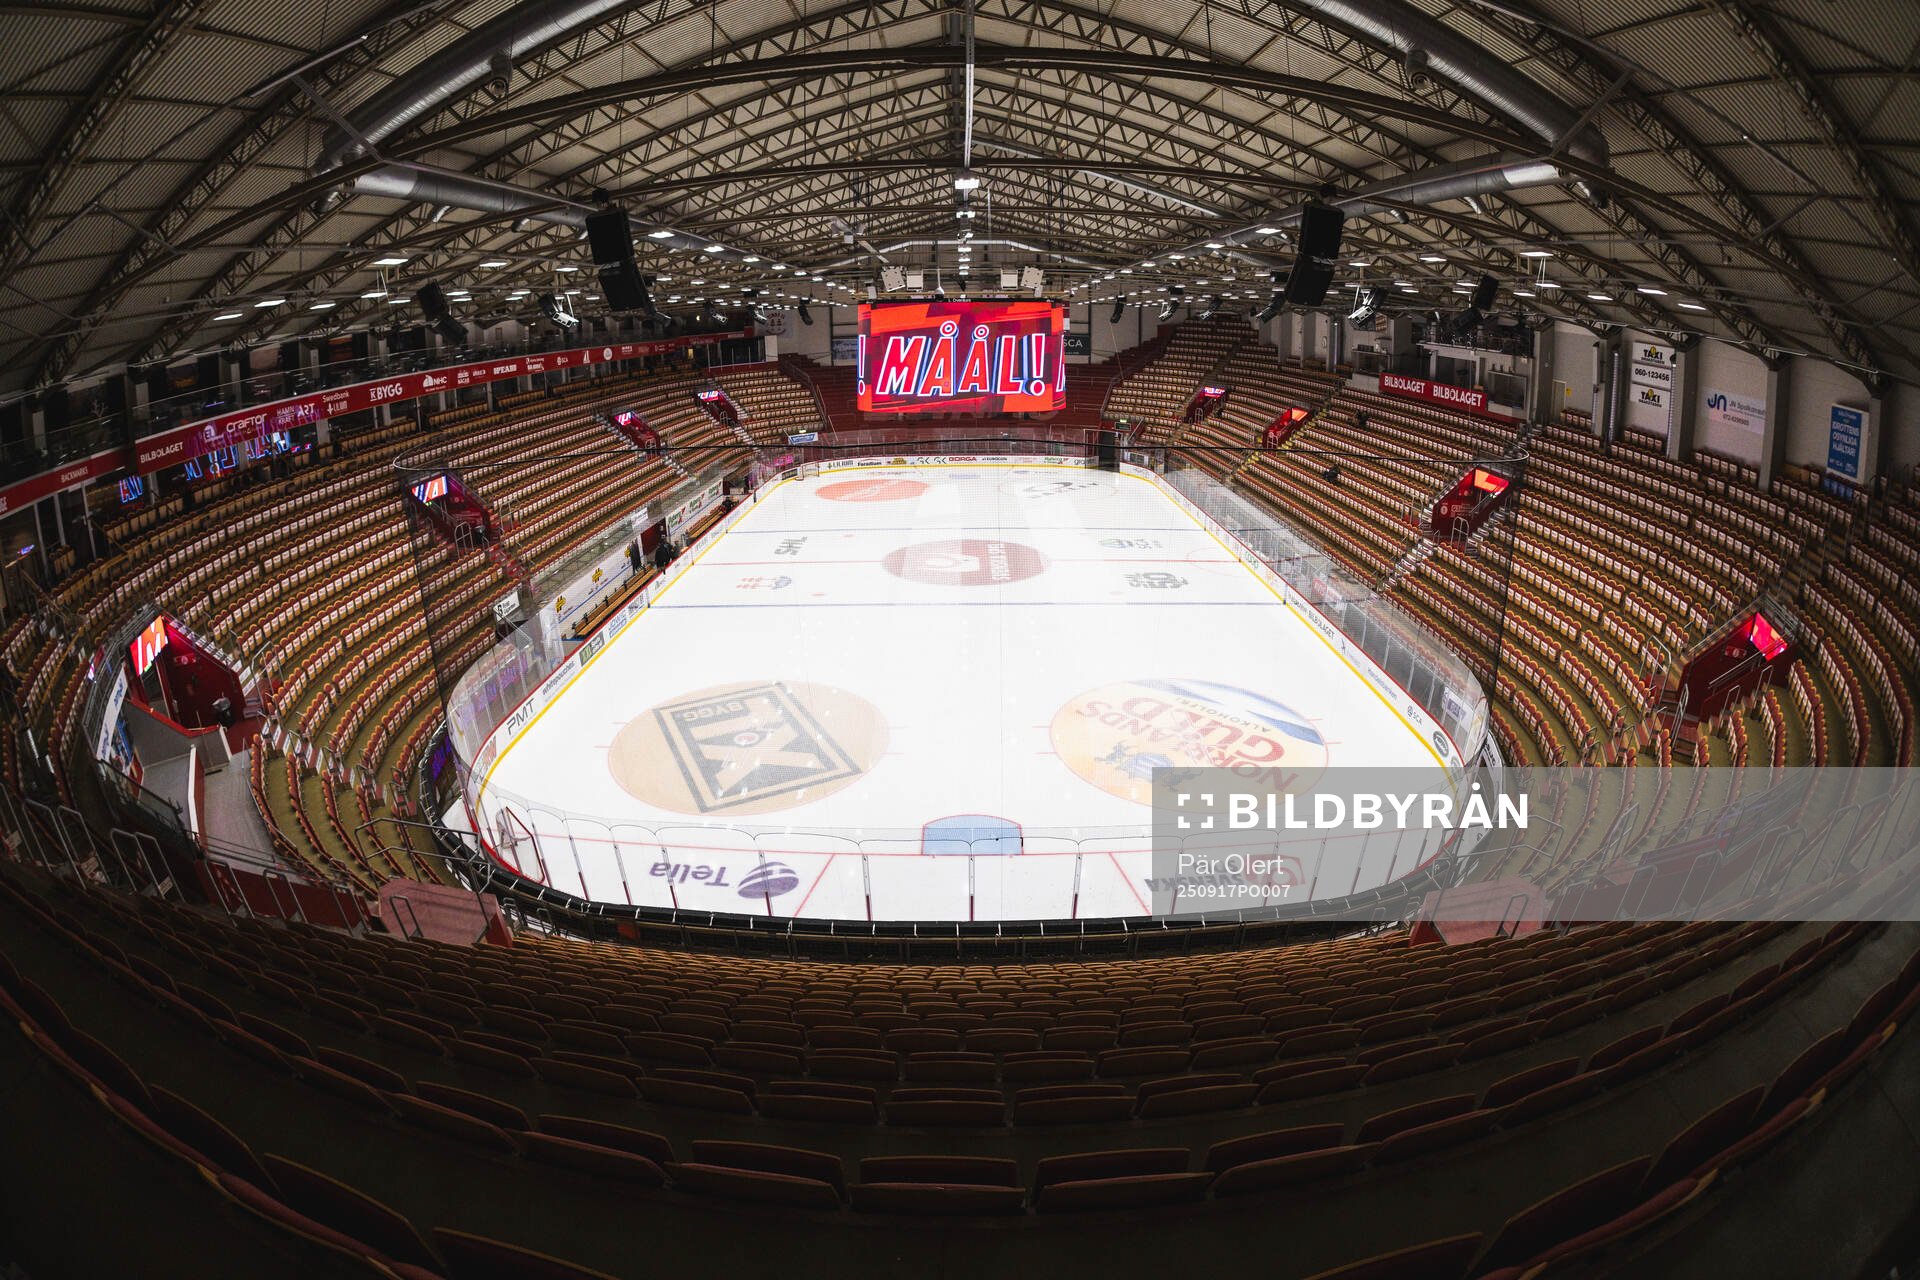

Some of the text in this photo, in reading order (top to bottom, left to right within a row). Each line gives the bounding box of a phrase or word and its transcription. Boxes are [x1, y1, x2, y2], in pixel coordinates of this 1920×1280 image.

[876, 320, 1046, 397] MÅÅL!
[1643, 349, 1663, 361] TAXI
[433, 376, 448, 386] NHC
[1634, 367, 1670, 382] 060-123456
[1384, 375, 1482, 407] BILBOLAGET BILBOLAGET
[1640, 391, 1661, 404] TAXI
[140, 441, 184, 464] BILBOLAGET
[506, 697, 535, 736] PMT
[682, 700, 745, 722] BYGG
[649, 861, 730, 888] Telia
